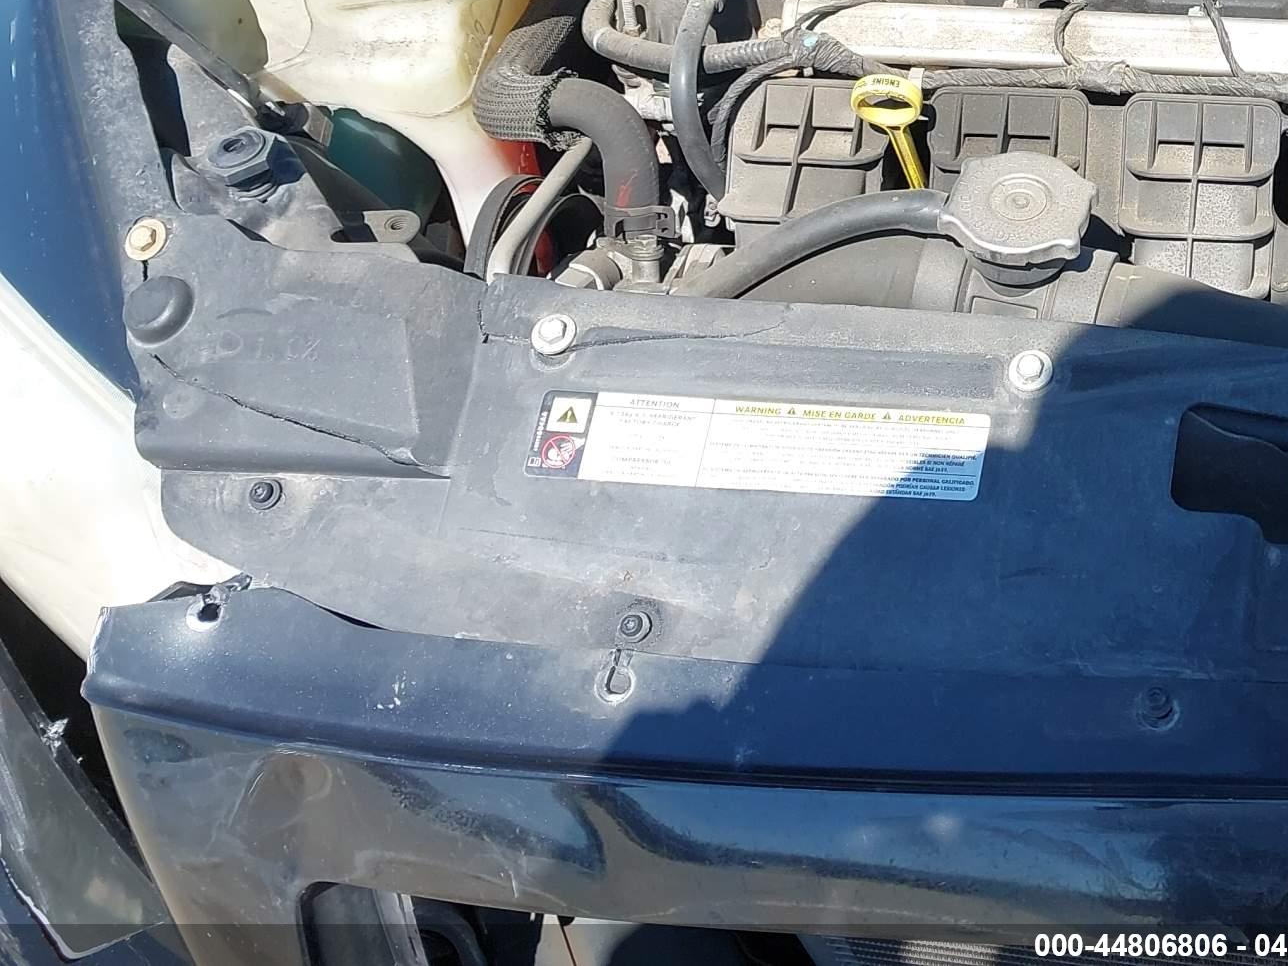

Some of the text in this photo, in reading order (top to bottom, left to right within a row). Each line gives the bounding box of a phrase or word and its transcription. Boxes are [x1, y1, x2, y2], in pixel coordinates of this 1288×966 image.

[629, 398, 681, 409] ATTENTION
[735, 405, 966, 425] WARNING MISE EN GARDE ADVERTENCIA
